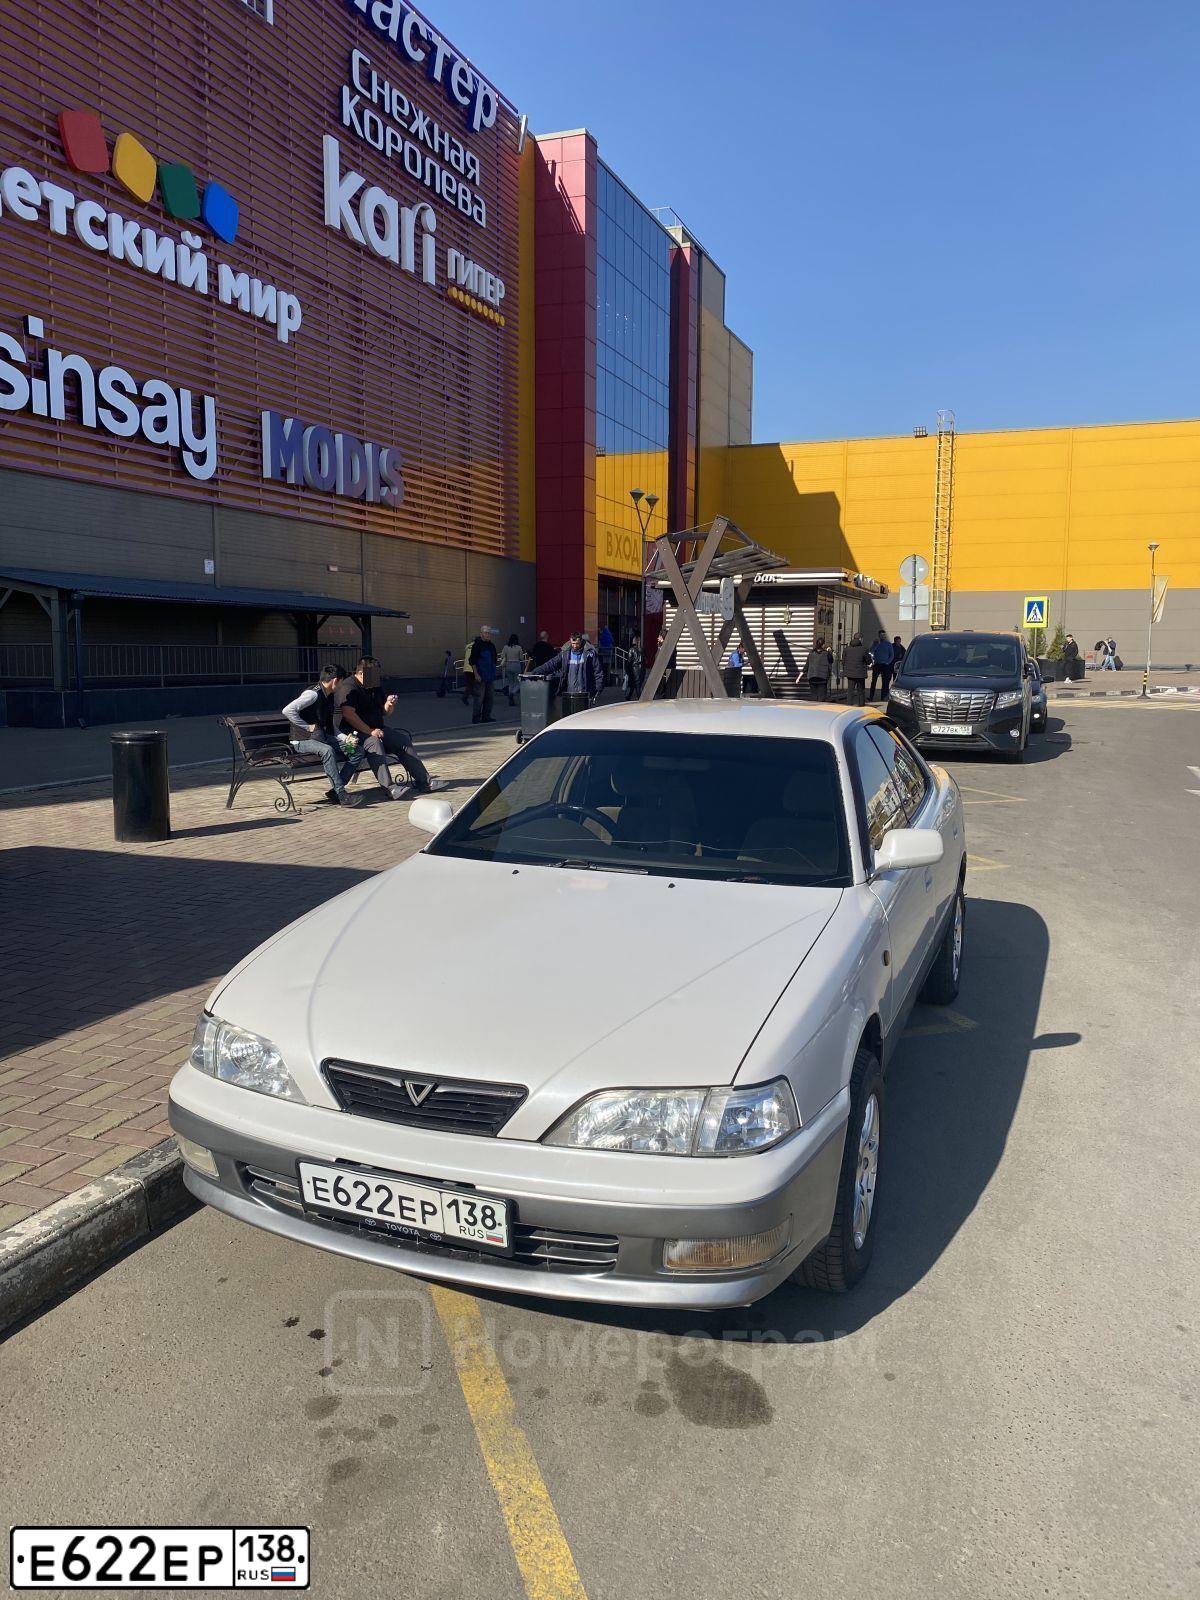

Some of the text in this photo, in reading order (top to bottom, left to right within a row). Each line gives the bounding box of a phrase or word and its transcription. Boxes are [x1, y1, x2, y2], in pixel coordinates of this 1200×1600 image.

[352, 0, 498, 132] астер
[322, 134, 437, 286] kari
[0, 166, 302, 343] етский мир
[261, 410, 404, 507] MODIS
[606, 531, 640, 567] ВХОД
[312, 1175, 497, 1231] Е622ЕР 138
[385, 1222, 420, 1237] TOYOTA
[459, 1225, 484, 1239] RUS
